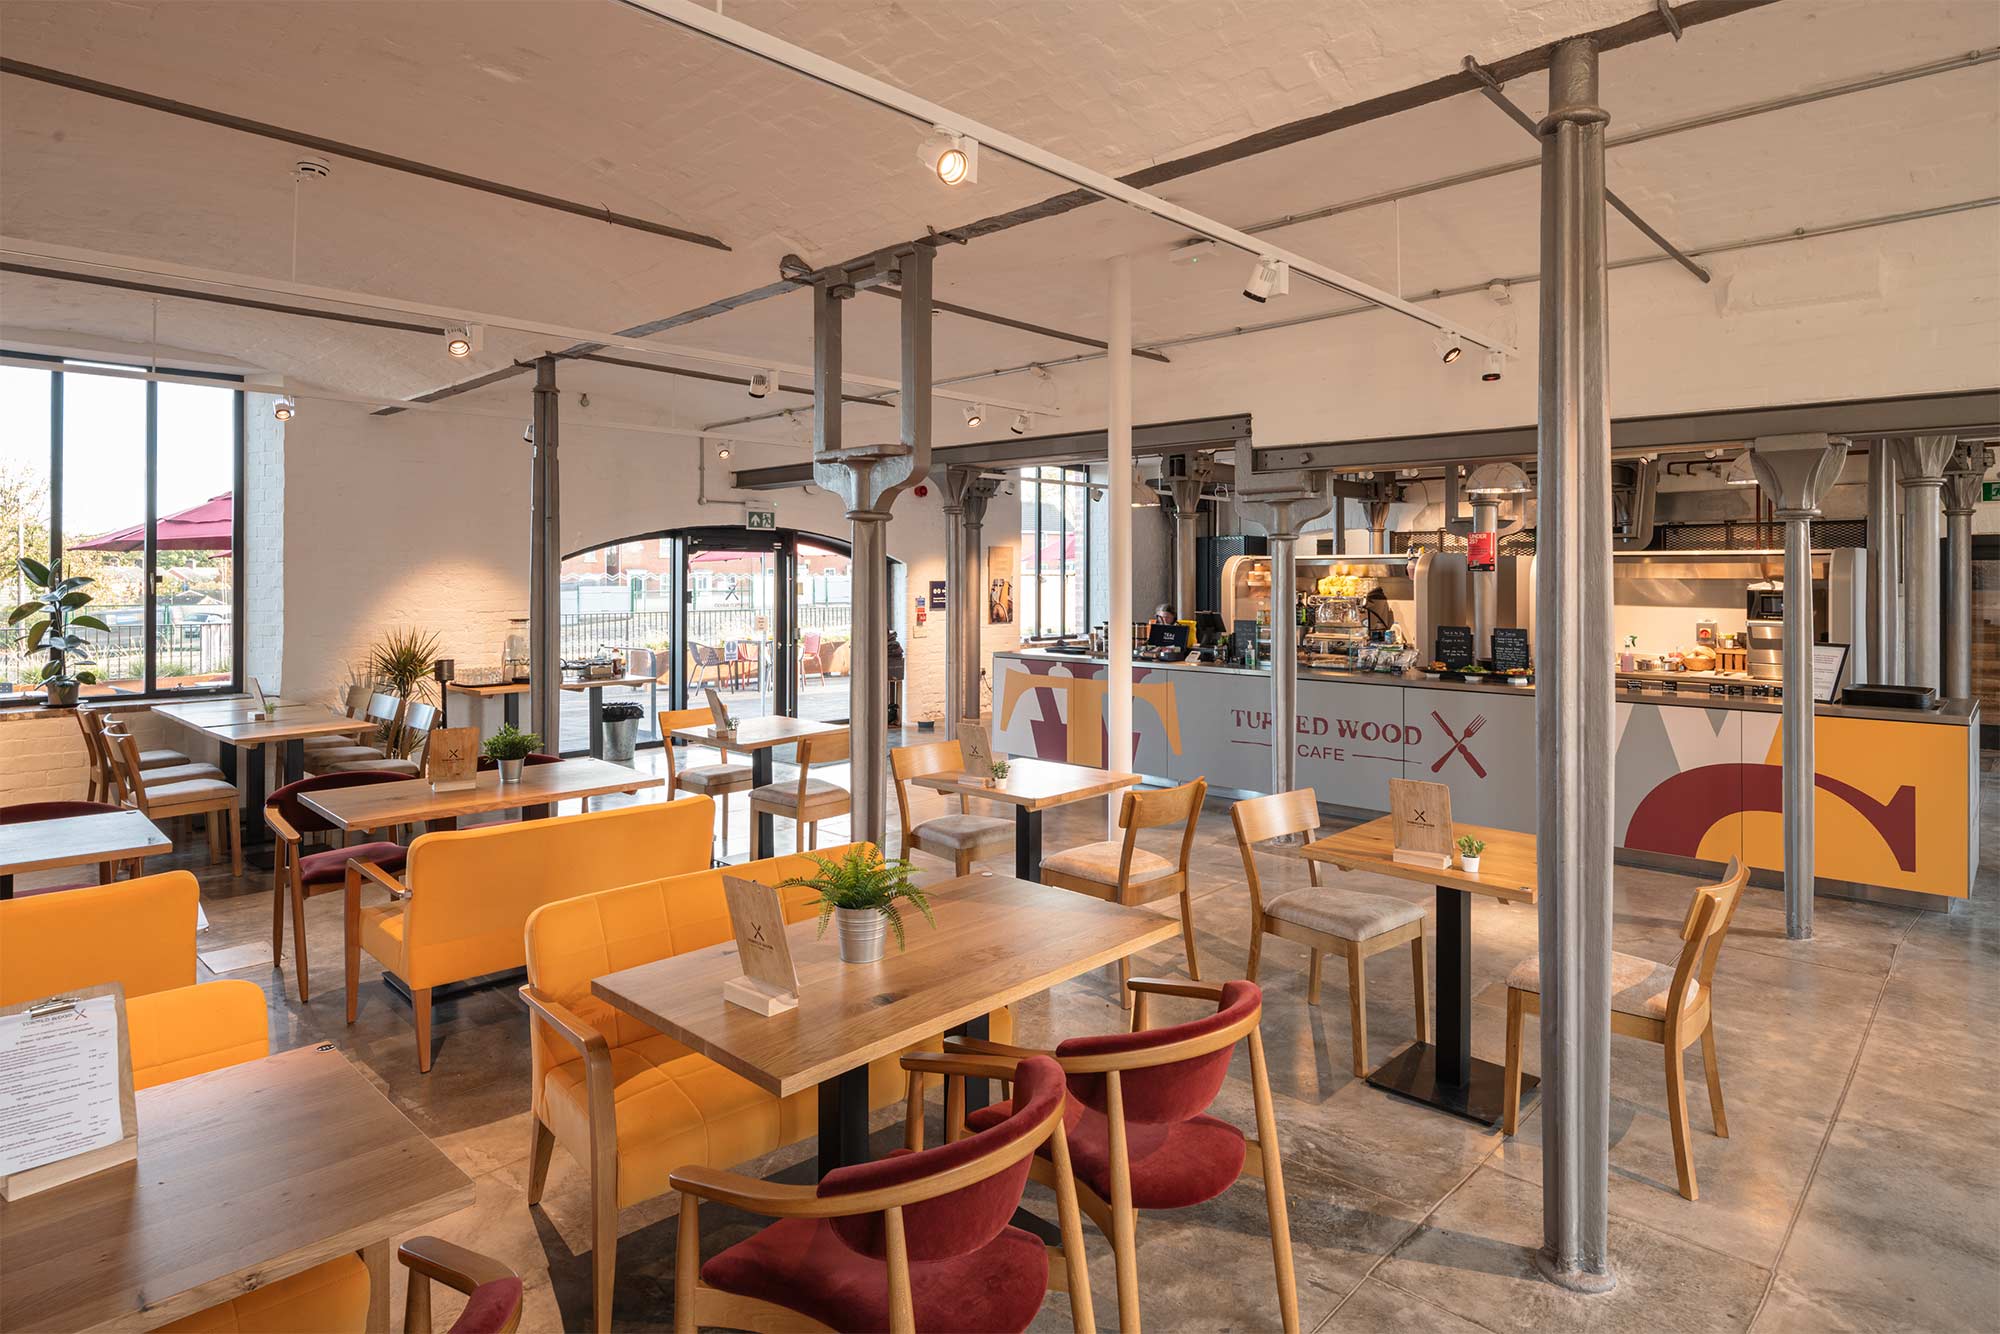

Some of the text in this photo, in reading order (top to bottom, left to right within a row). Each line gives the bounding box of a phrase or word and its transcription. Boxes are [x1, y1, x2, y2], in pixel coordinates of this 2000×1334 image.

[1230, 709, 1422, 746] TURED WOOD
[1297, 744, 1345, 762] CAFE
